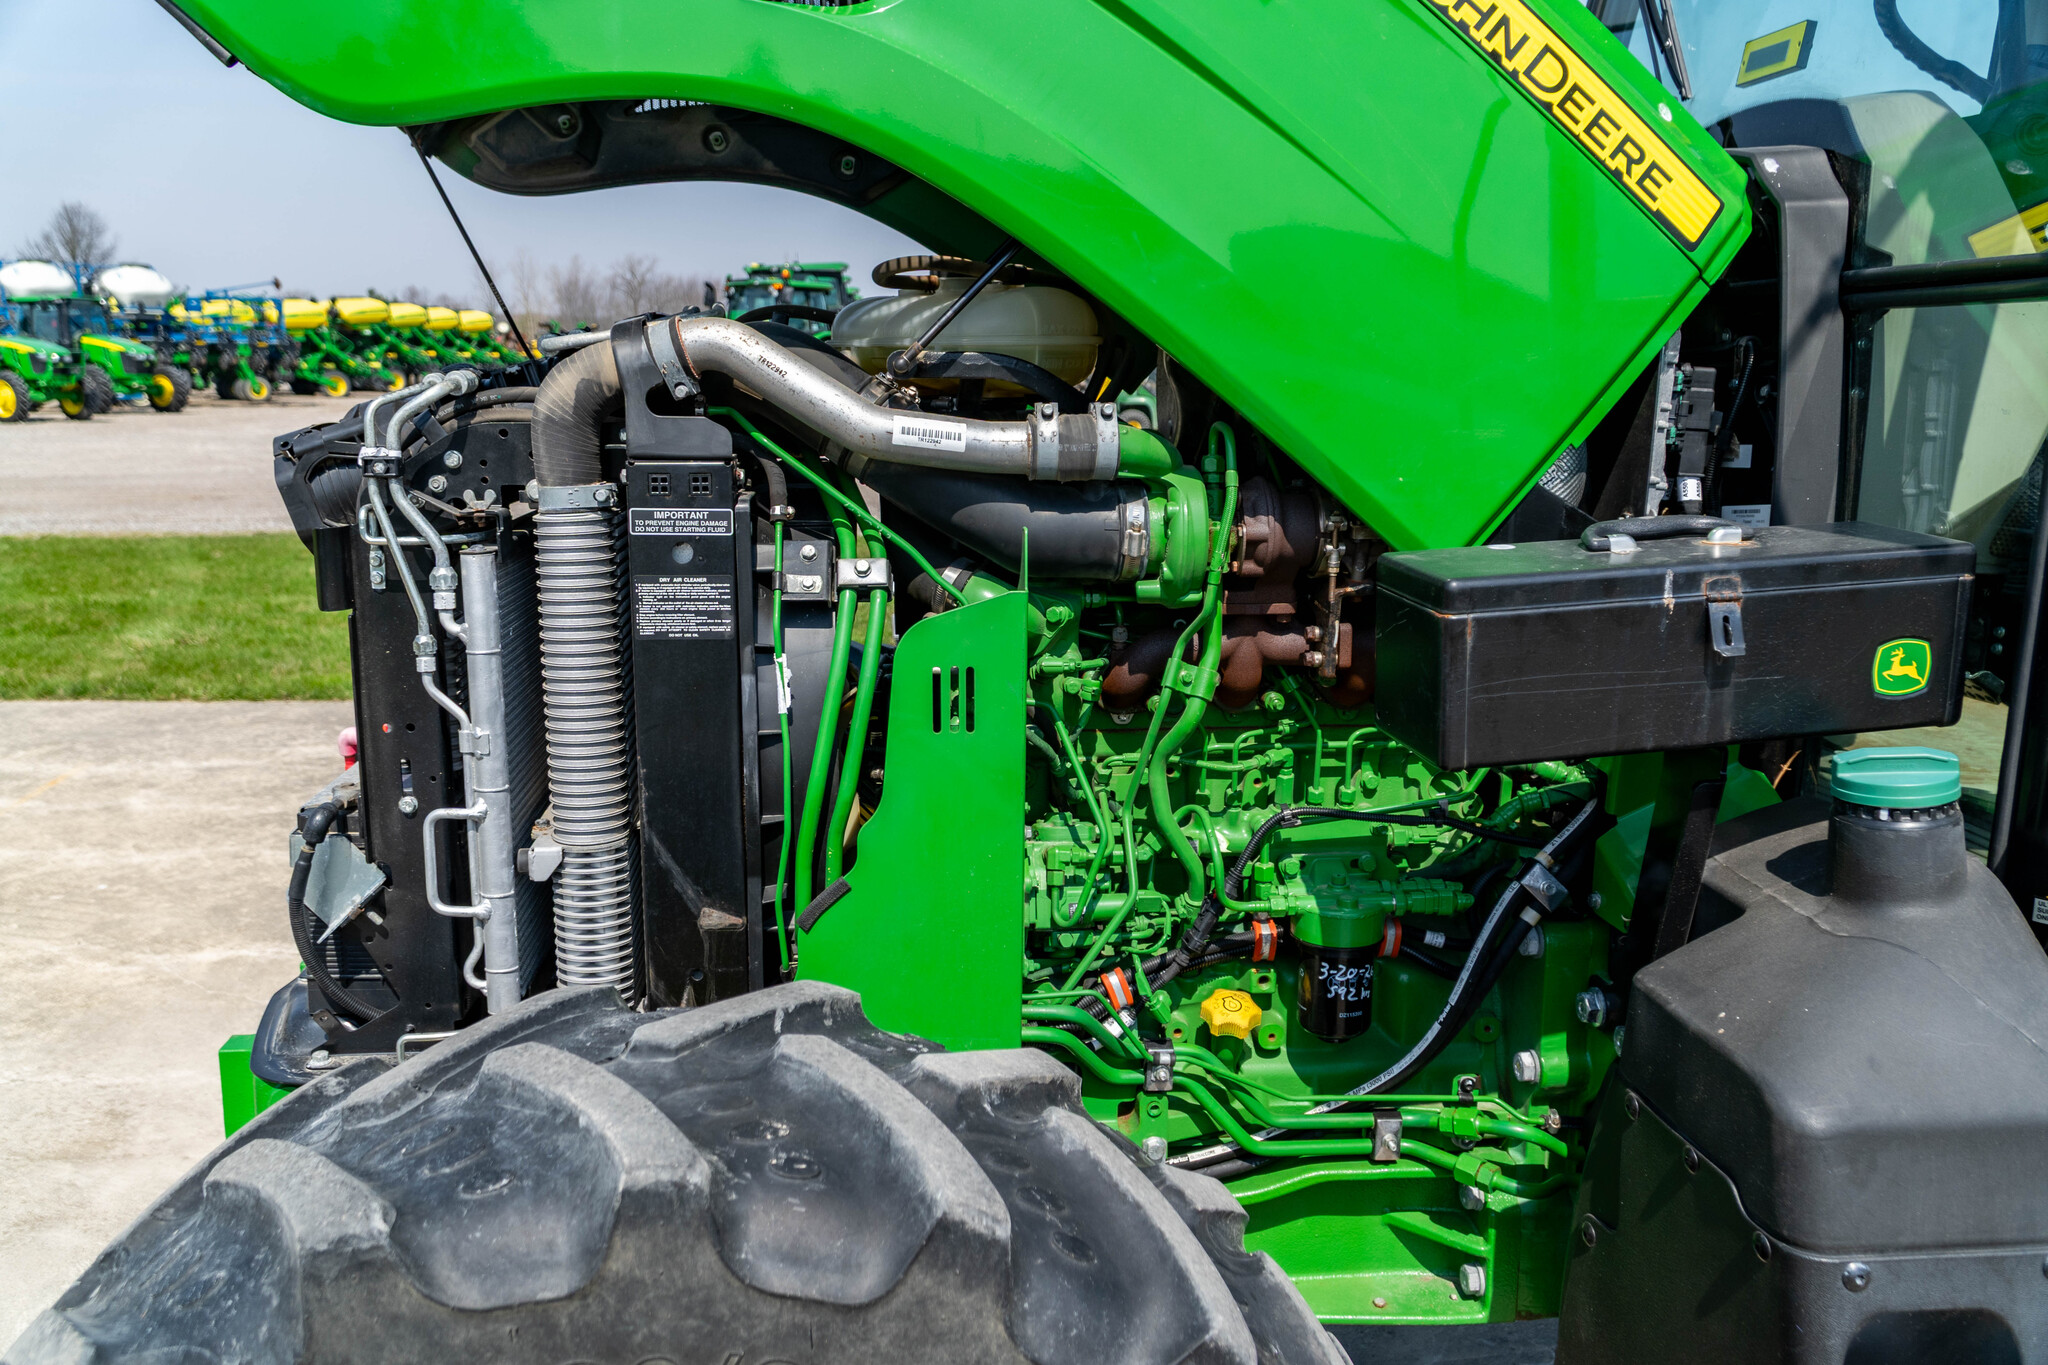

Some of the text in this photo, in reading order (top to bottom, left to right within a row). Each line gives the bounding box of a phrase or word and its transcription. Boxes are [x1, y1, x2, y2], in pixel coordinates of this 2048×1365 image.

[1522, 43, 1673, 203] DEERE
[758, 354, 788, 378] TR122942
[653, 511, 709, 519] IMPORTANT
[1327, 985, 1359, 1001] 592
